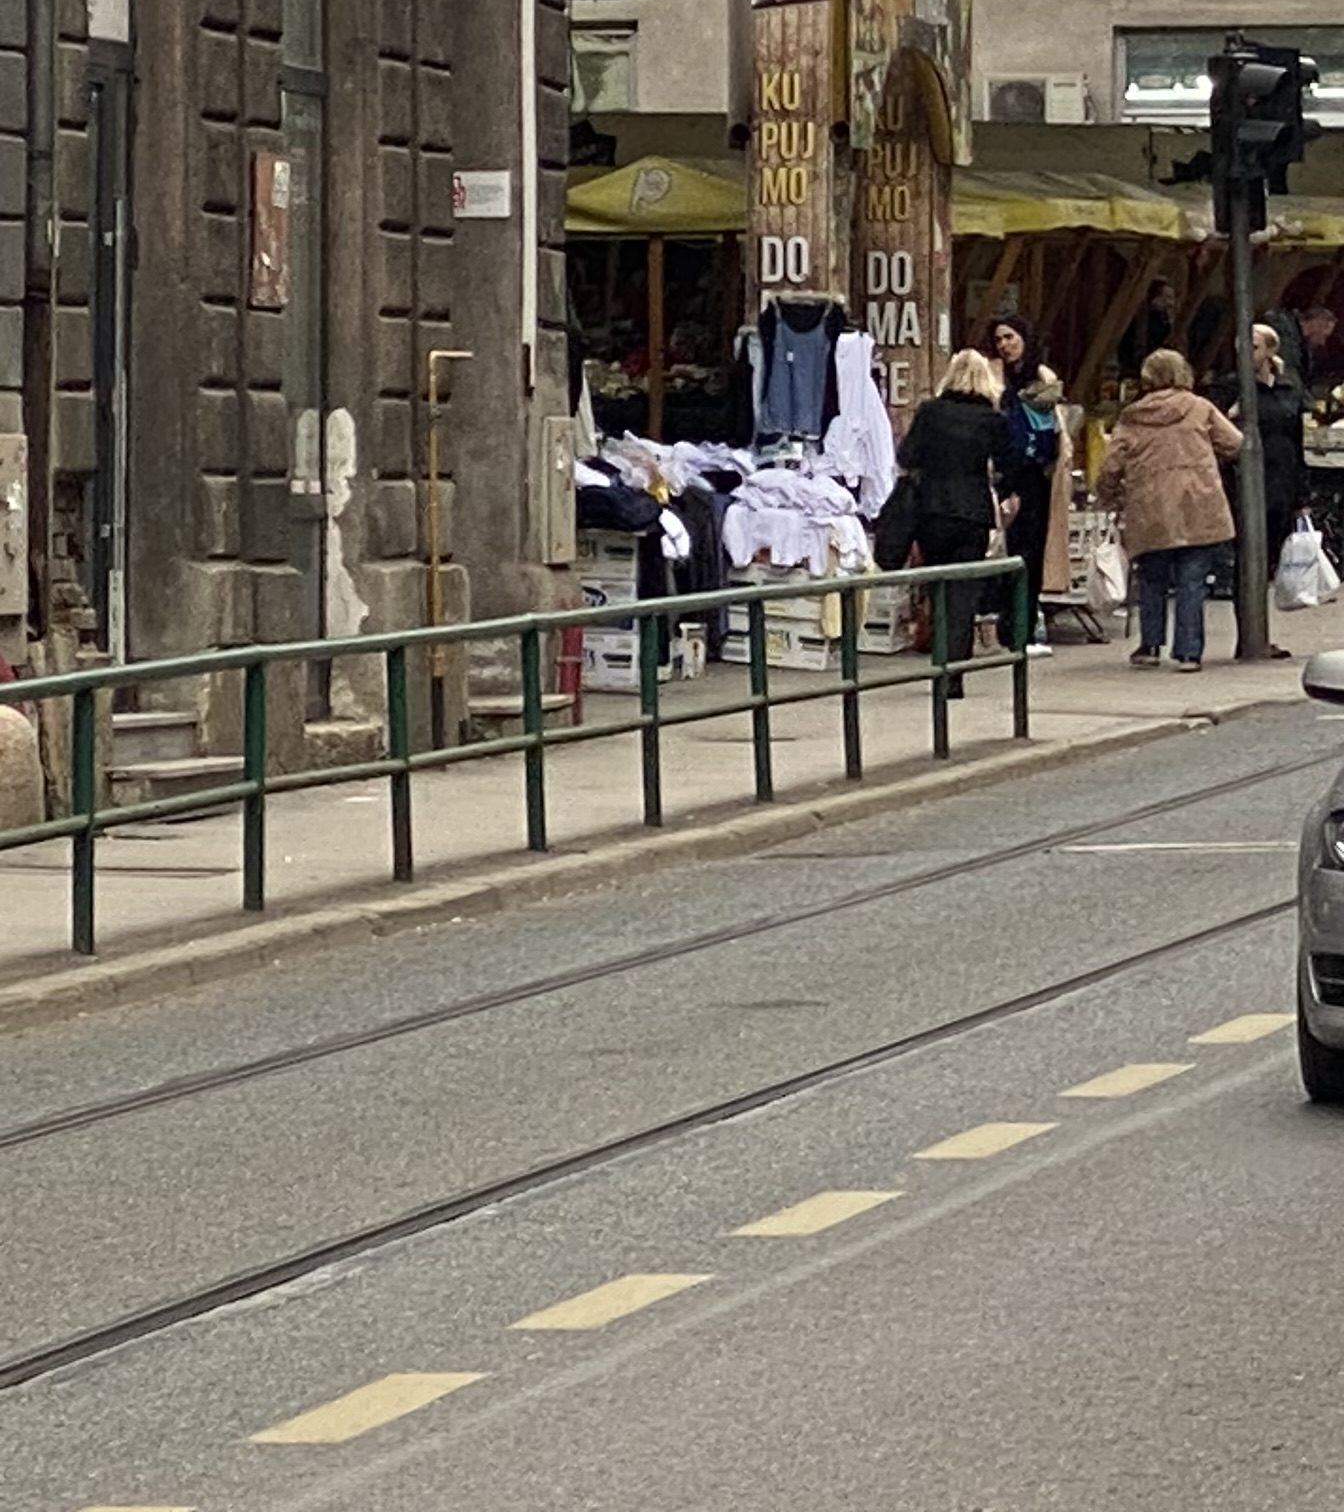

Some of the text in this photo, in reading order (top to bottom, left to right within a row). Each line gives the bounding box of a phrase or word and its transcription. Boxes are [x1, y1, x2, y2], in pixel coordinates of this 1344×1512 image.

[761, 72, 801, 110] KU
[760, 121, 815, 160] PUJ
[760, 167, 808, 206] MO
[867, 185, 911, 222] MO
[760, 236, 810, 283] DO
[867, 250, 914, 296] DO
[866, 301, 922, 347] MA
